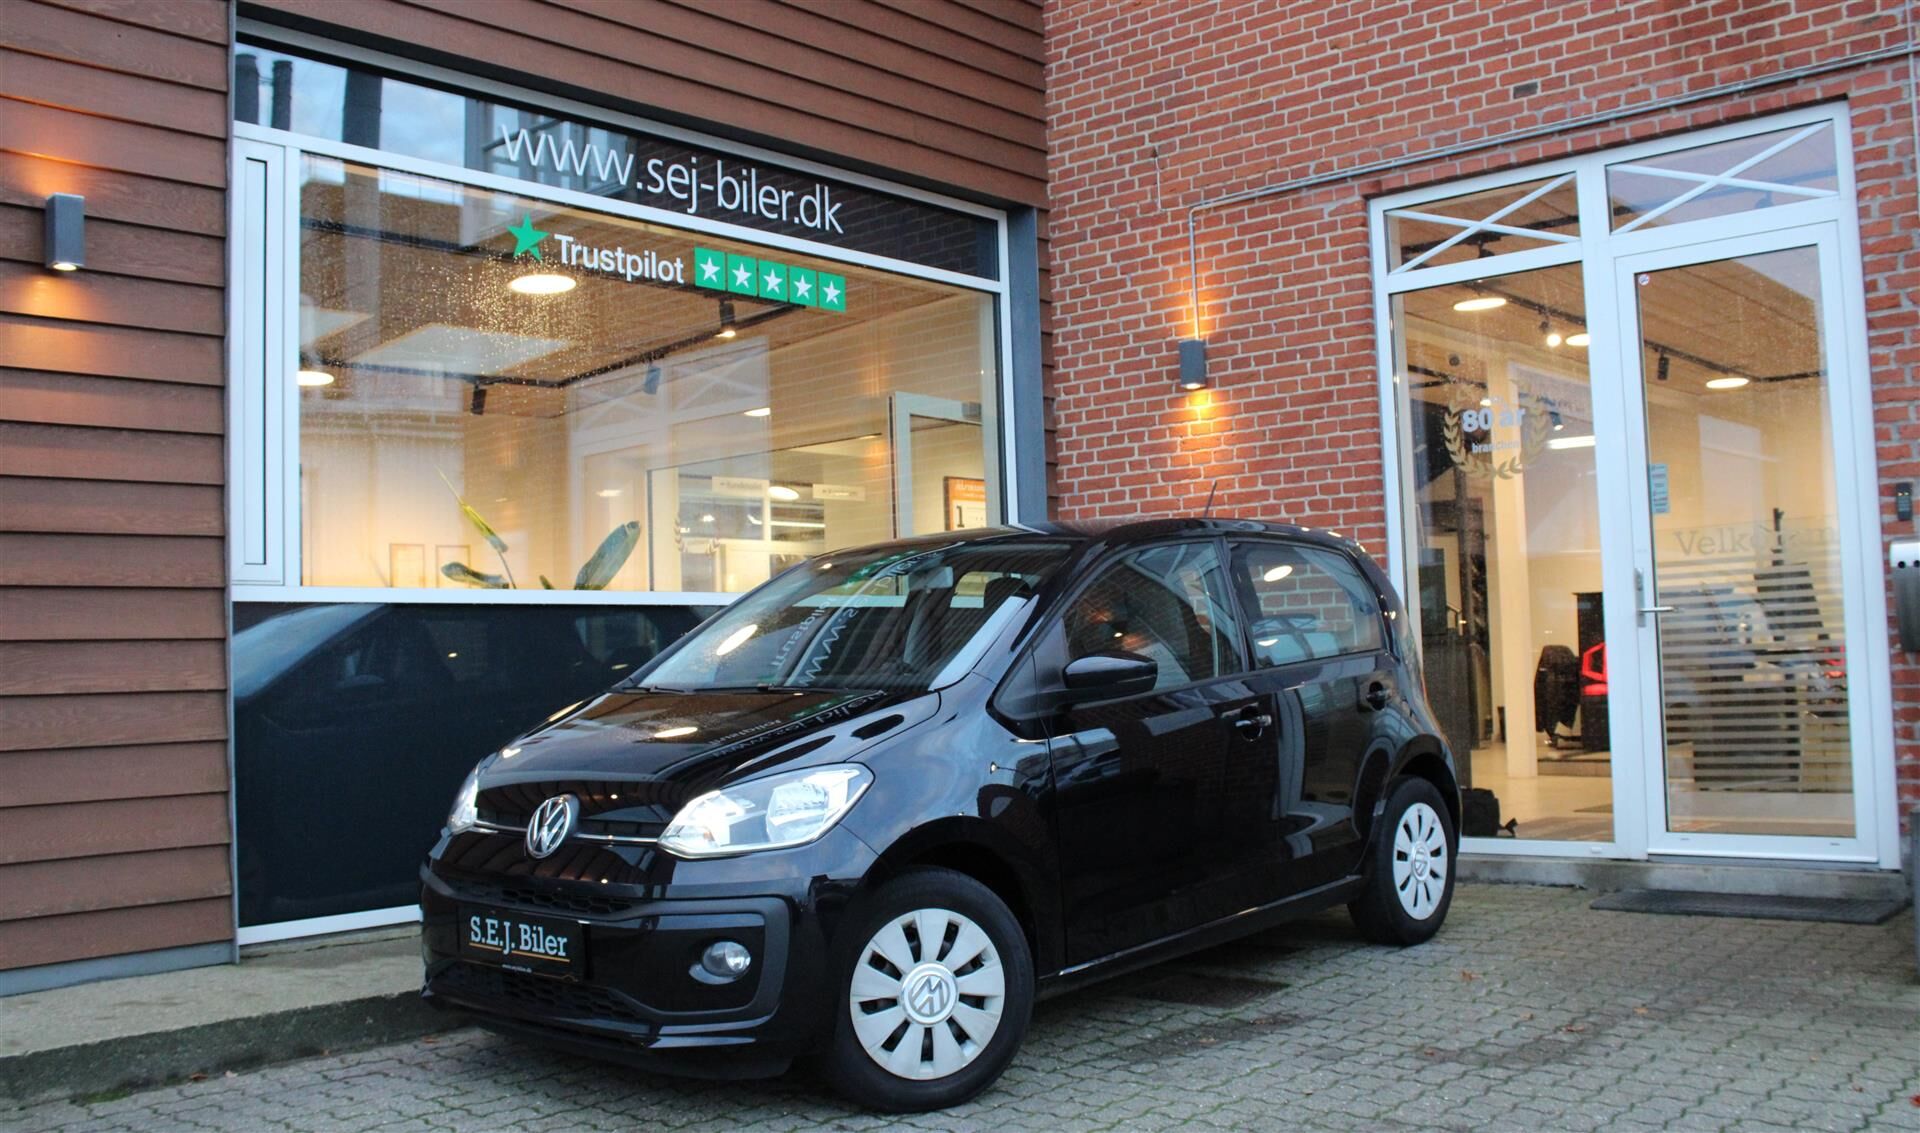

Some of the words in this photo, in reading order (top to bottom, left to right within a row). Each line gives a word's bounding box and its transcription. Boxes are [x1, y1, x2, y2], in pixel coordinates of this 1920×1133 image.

[500, 124, 844, 234] www.sej-biler.dk
[554, 234, 685, 284] Trustpilot
[1462, 407, 1494, 433] 80
[470, 915, 515, 955] S.E.J.
[519, 923, 568, 957] Biler
